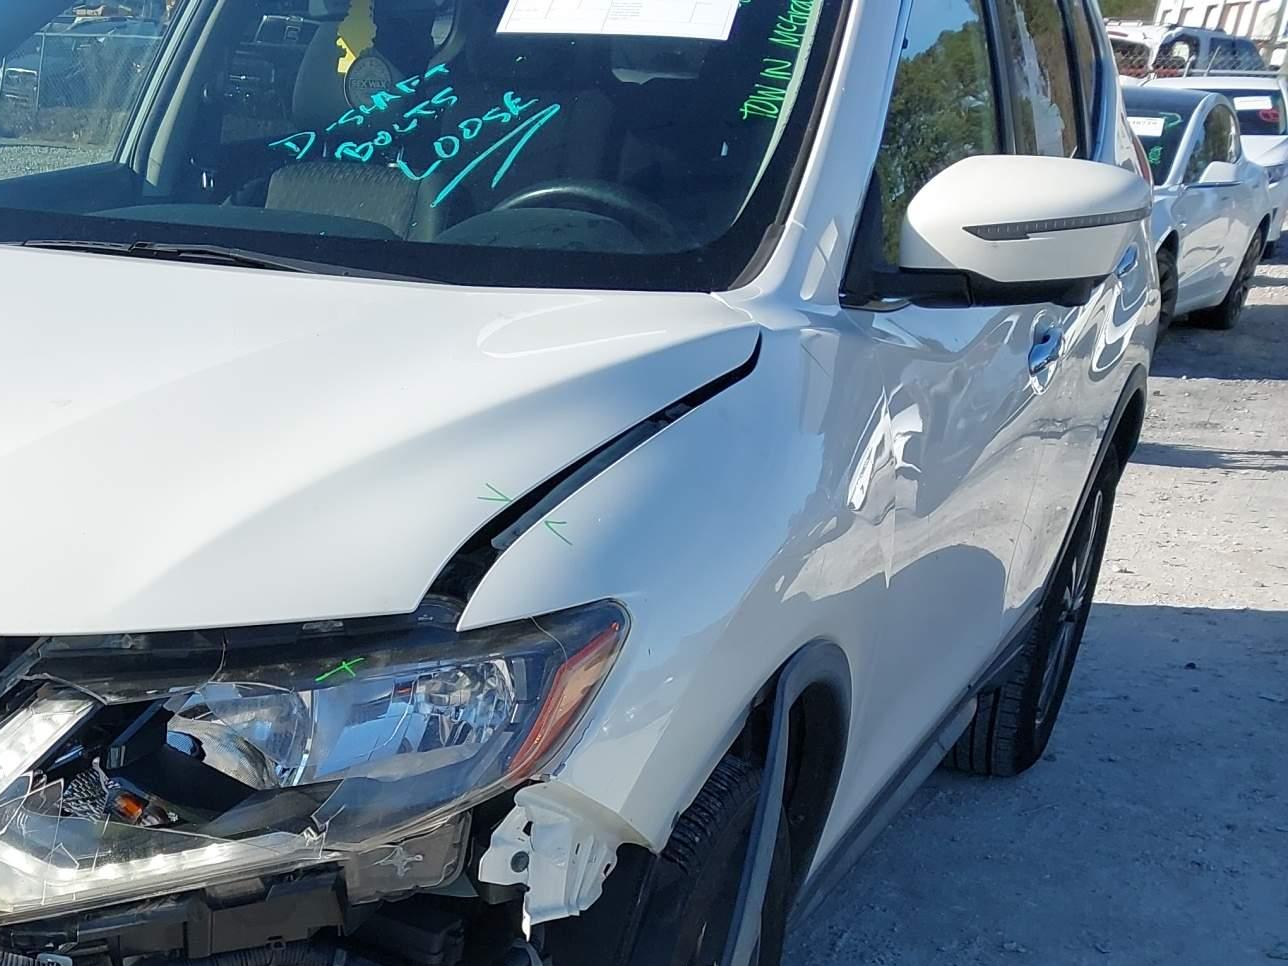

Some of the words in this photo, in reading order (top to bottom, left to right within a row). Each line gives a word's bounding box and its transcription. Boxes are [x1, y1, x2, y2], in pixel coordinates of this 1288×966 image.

[759, 58, 792, 80] IN
[334, 86, 458, 162] BOLTS
[739, 83, 787, 120] TOW
[396, 91, 539, 181] LOOSE
